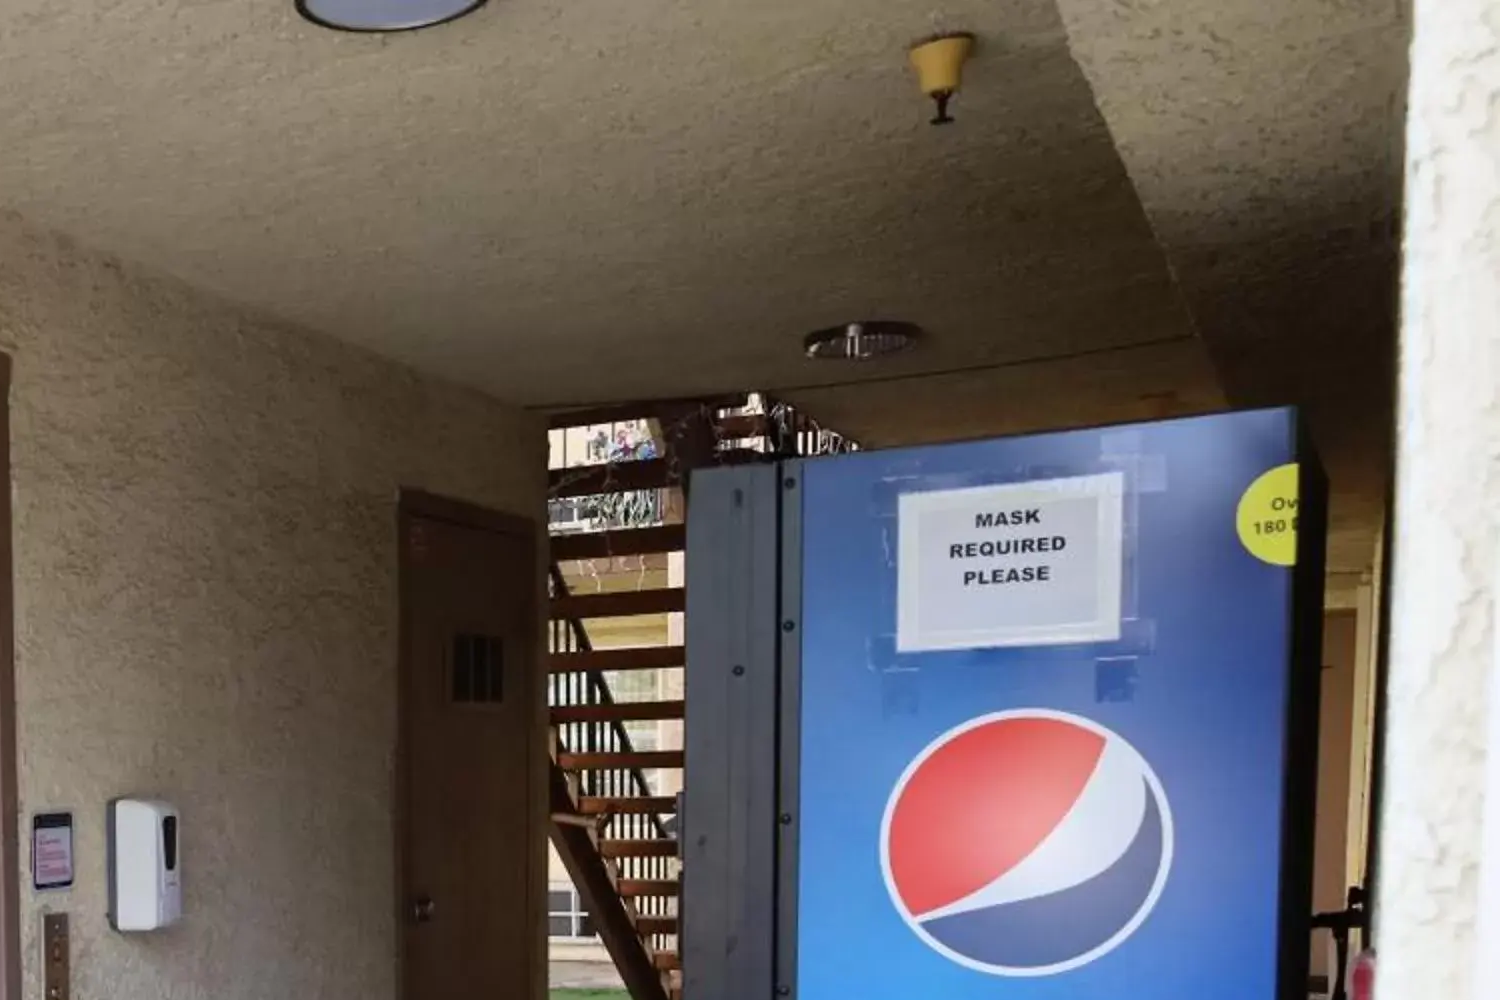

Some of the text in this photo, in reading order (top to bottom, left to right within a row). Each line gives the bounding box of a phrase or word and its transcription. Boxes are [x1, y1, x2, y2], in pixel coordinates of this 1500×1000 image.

[975, 509, 1041, 528] MASK
[950, 536, 1066, 558] REQUIRED
[964, 565, 1050, 586] PLEASE
